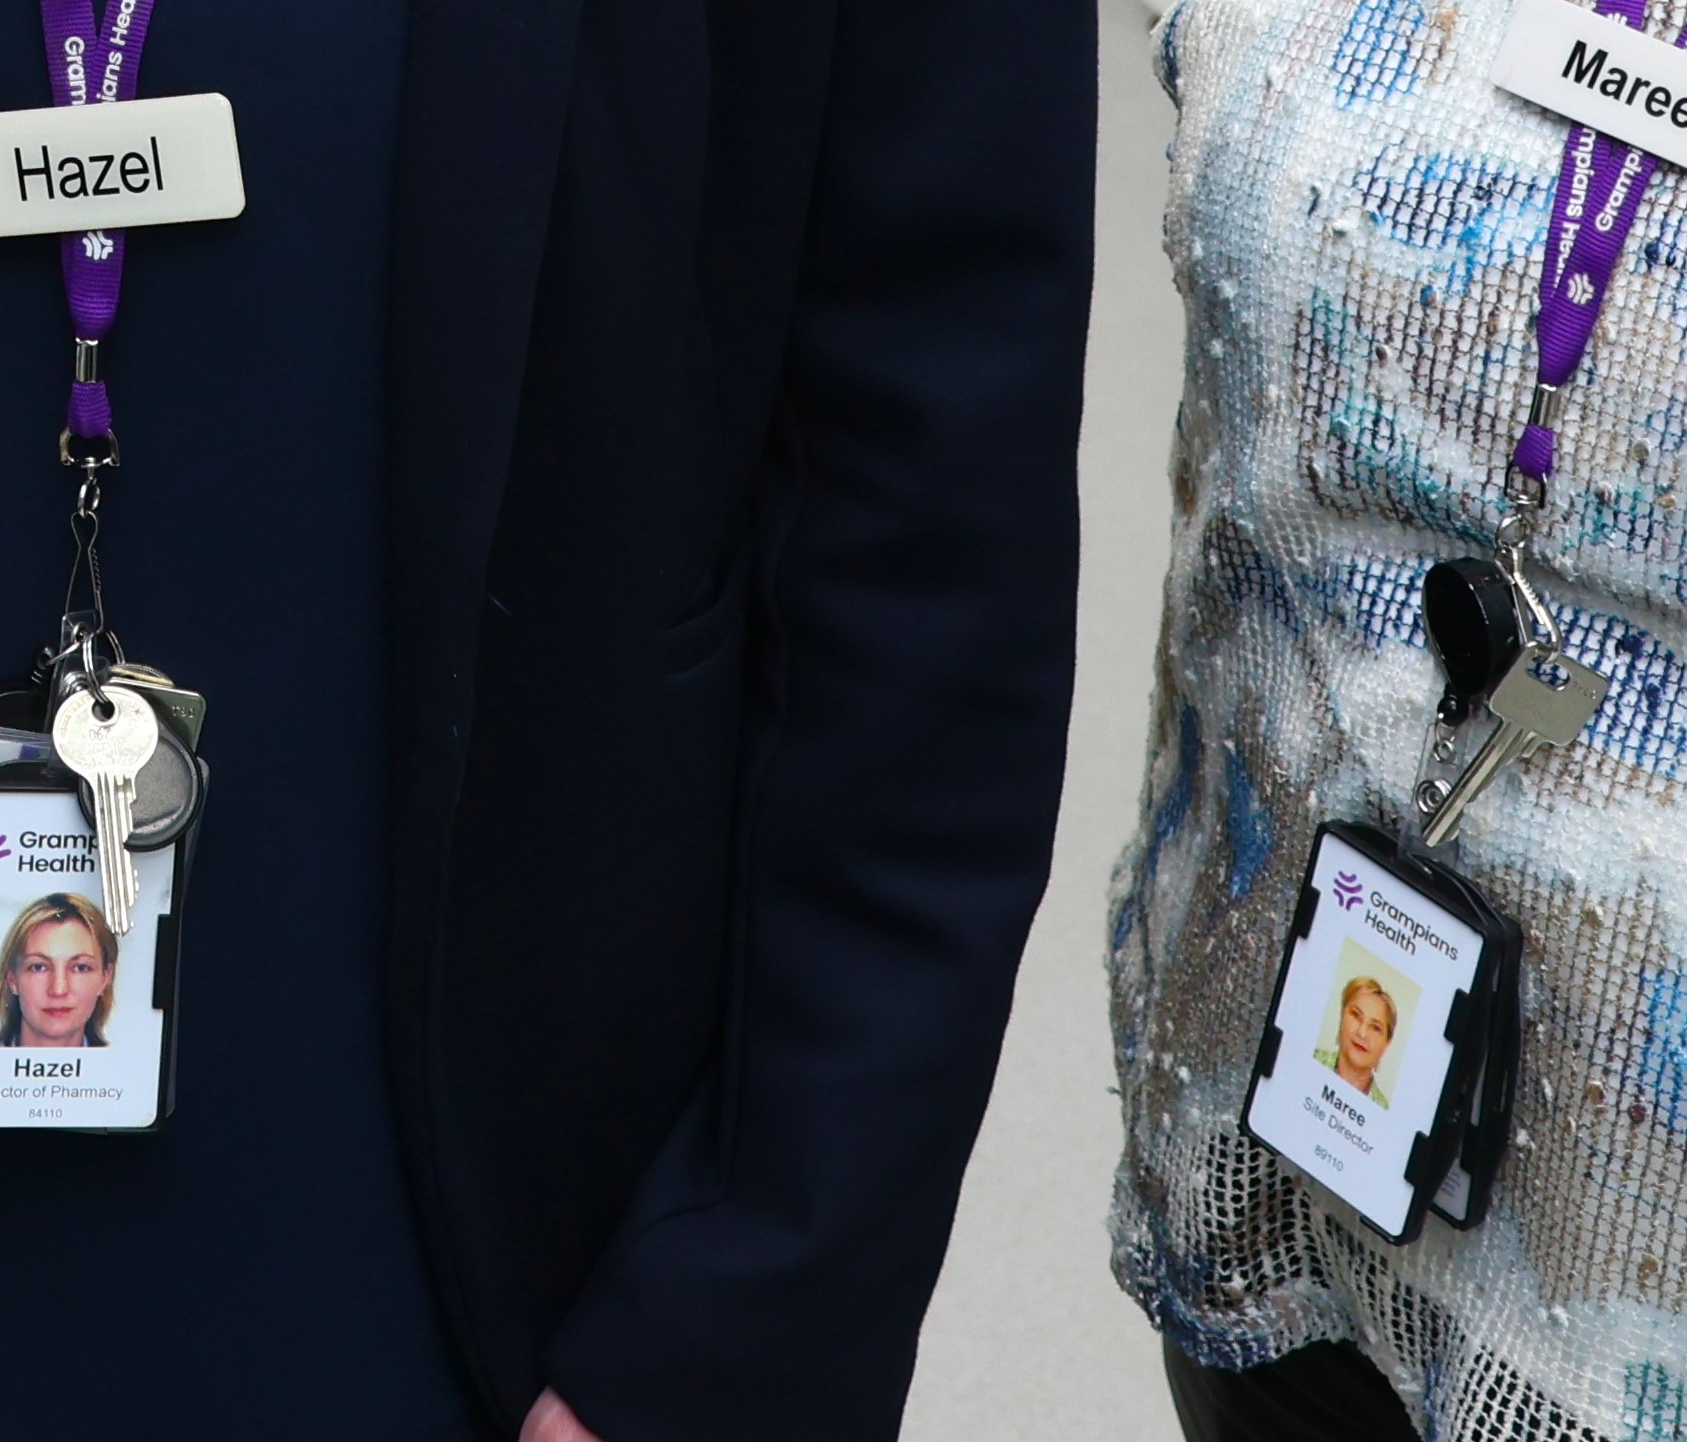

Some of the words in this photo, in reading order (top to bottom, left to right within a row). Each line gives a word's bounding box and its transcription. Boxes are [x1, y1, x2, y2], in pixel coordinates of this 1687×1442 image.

[13, 136, 165, 202] Hazel
[19, 830, 99, 855] Gramp
[17, 854, 96, 873] Health
[1364, 909, 1417, 956] Health
[1370, 891, 1459, 961] Grampians
[13, 1058, 82, 1078] Hazel
[32, 1084, 47, 1099] of
[50, 1084, 124, 1101] Pharmacy
[1320, 1084, 1367, 1127] Maree
[28, 1108, 63, 1119] 84110
[1302, 1096, 1326, 1122] Site
[1327, 1114, 1375, 1156] Director
